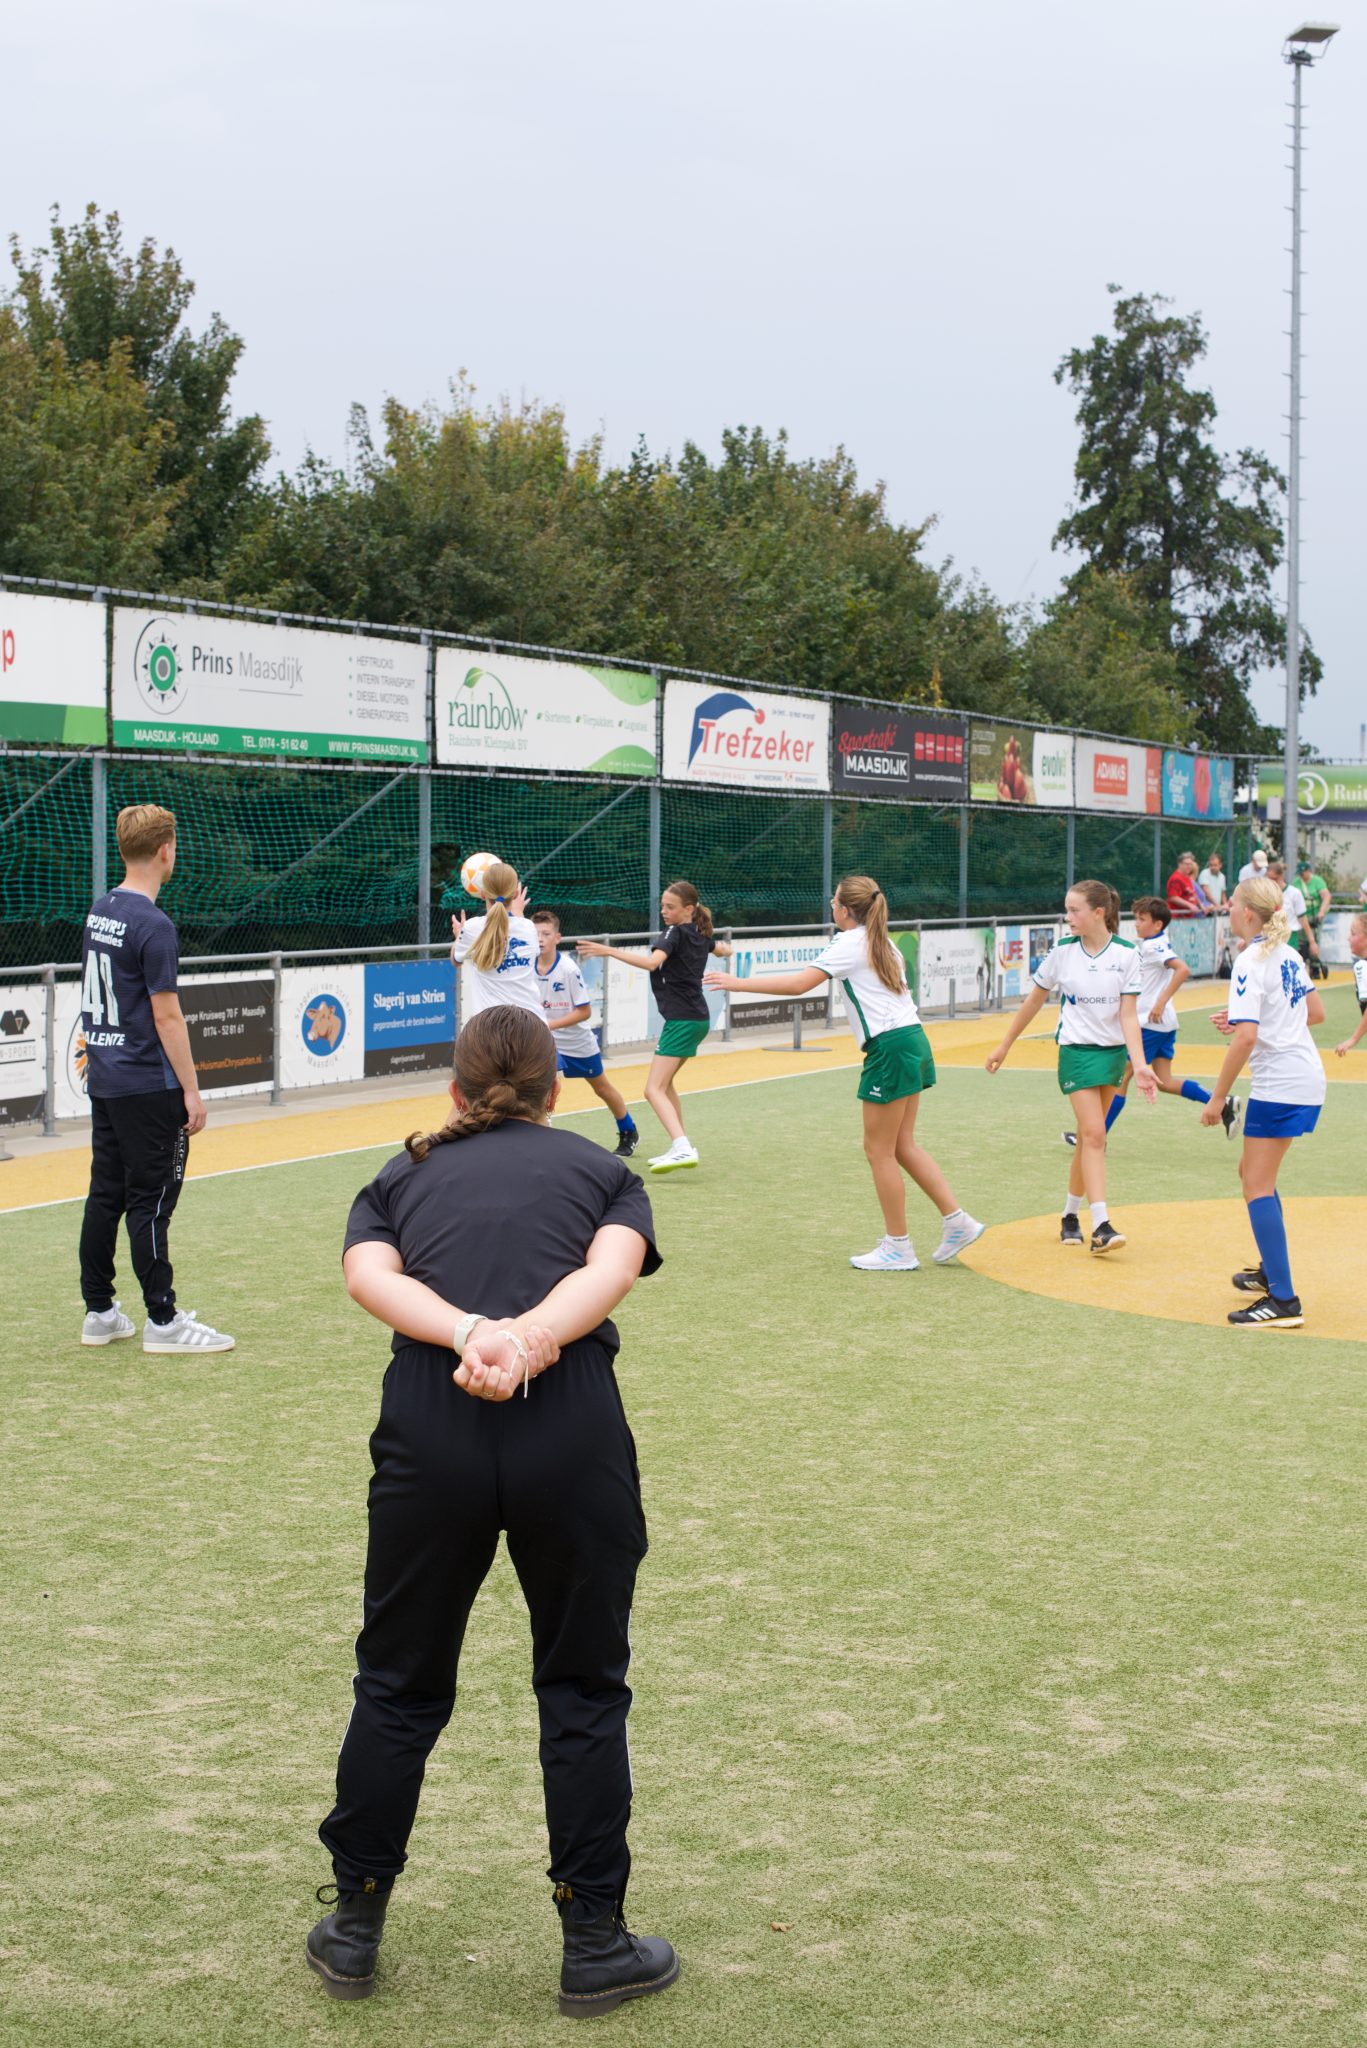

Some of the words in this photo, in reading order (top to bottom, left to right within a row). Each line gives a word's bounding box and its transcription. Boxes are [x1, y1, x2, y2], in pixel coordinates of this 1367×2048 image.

[192, 645, 233, 675] Prins
[239, 651, 303, 689] Maasdijk
[356, 673, 380, 685] INTERN
[356, 690, 378, 702] DIESEL
[448, 692, 528, 731] rainbow
[134, 729, 176, 743] MAASDIJK
[182, 731, 219, 745] HOLLAND
[258, 736, 275, 749] 0174
[700, 720, 815, 763] Trefzeker
[846, 755, 907, 776] MAASDIJK
[86, 914, 127, 936] RIJSVRIJ
[755, 950, 774, 964] WIM
[777, 949, 788, 963] DE
[373, 991, 404, 1011] Slagerij
[406, 994, 420, 1005] van
[422, 989, 446, 1004] Strien
[1078, 996, 1107, 1005] MOORE
[184, 1014, 198, 1025] ange
[84, 1031, 125, 1046] ALENTE
[203, 1026, 217, 1038] 0174
